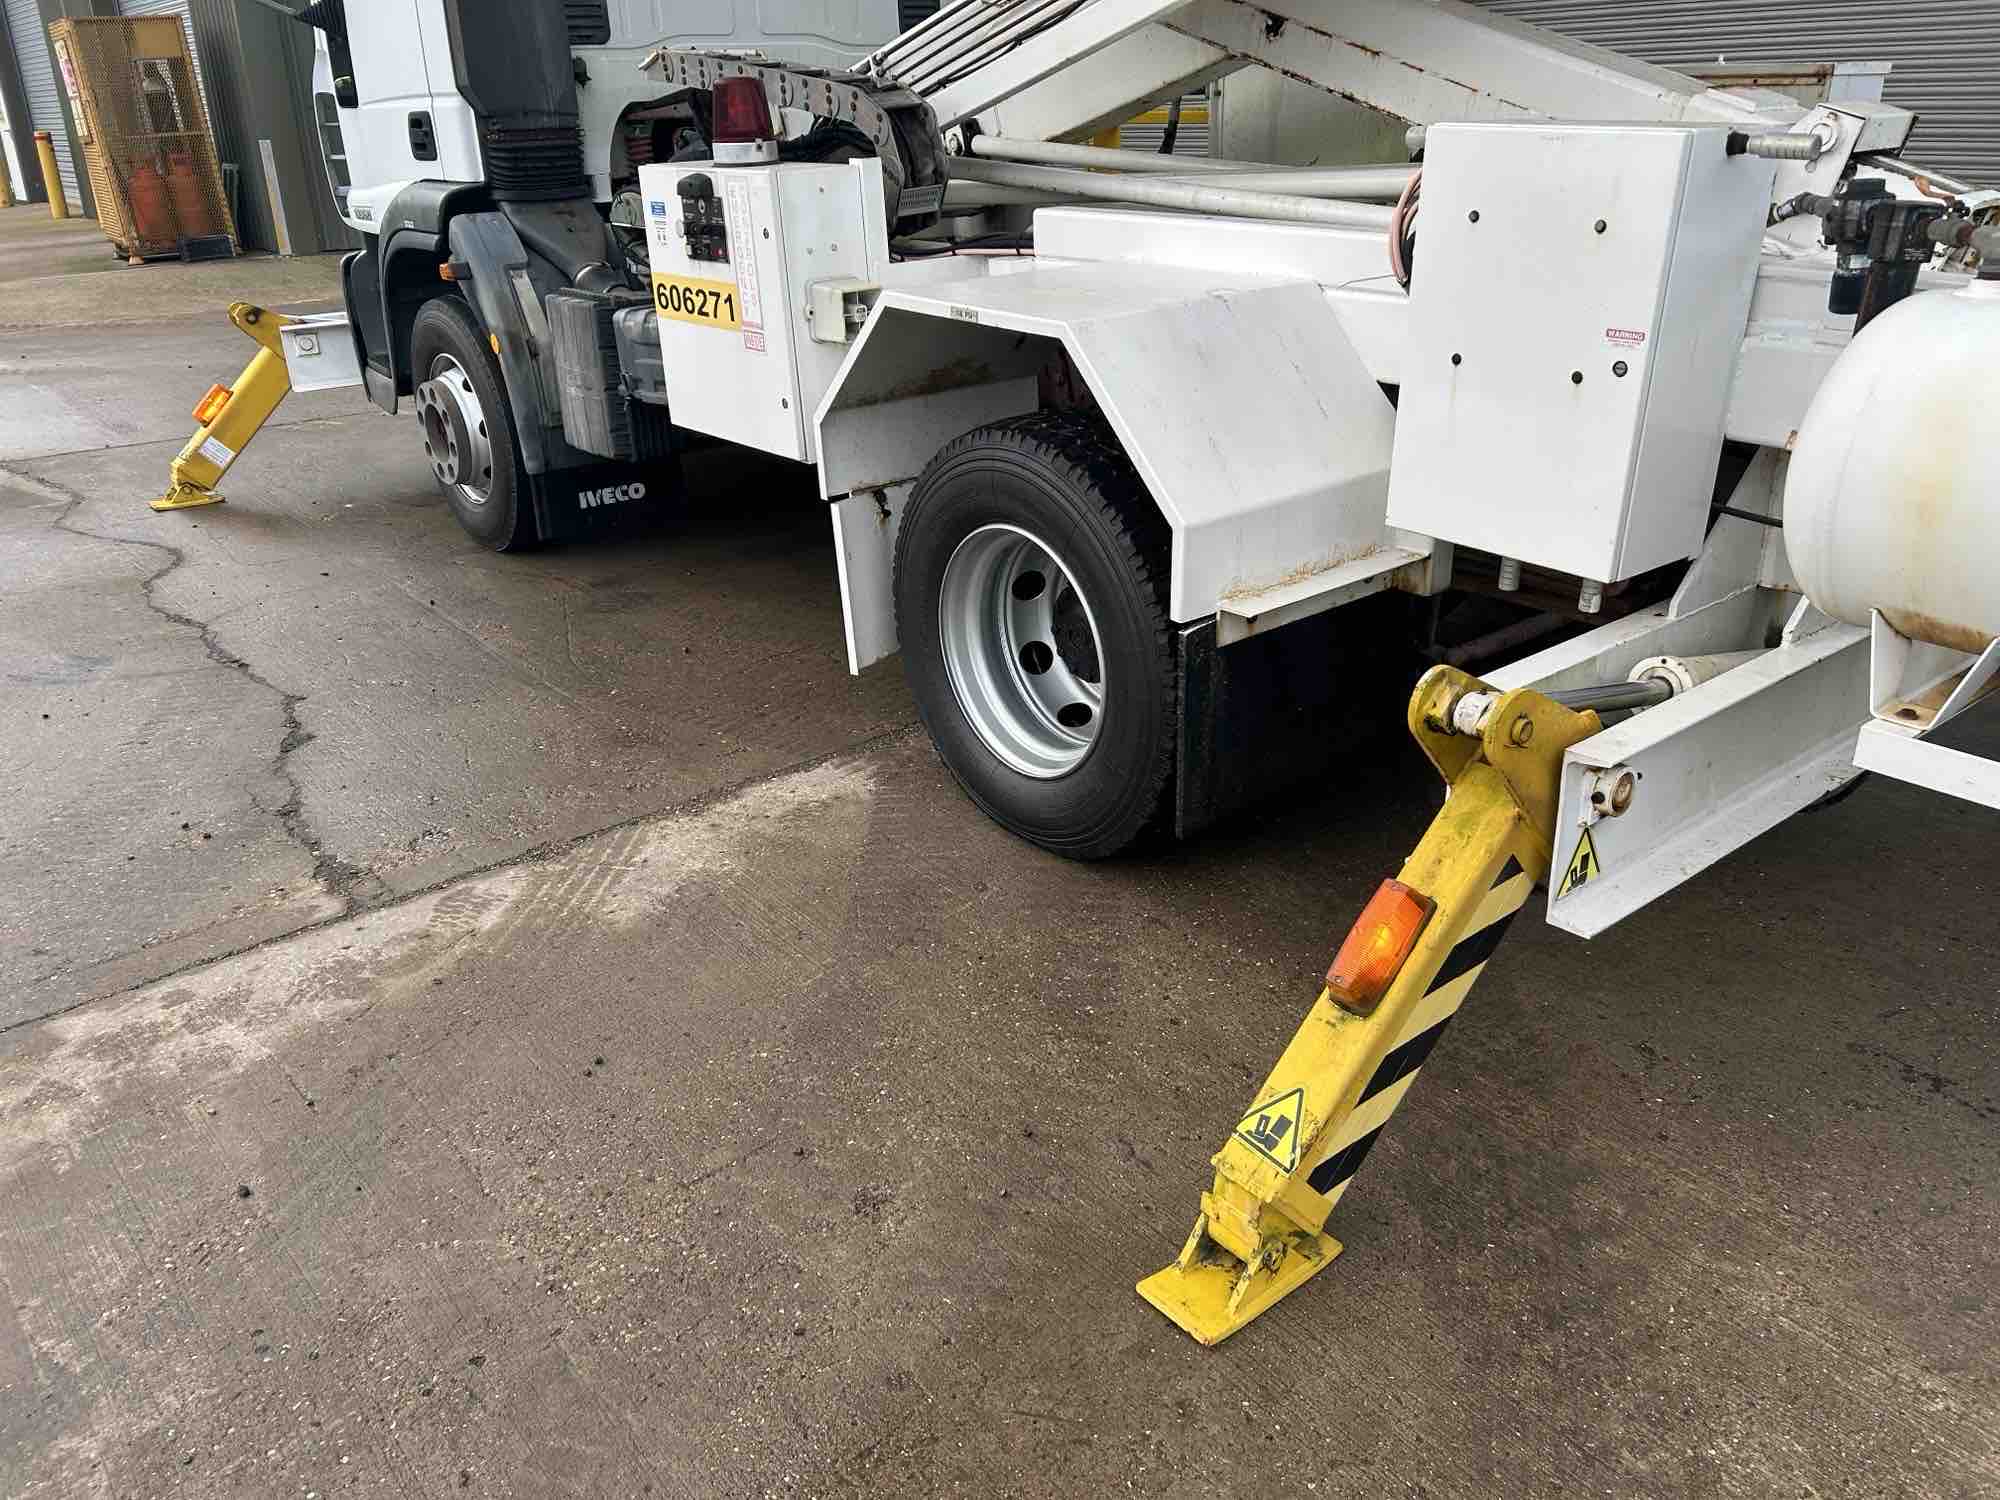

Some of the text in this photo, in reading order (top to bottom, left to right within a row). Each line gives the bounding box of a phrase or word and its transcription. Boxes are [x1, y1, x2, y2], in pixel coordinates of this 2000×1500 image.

[656, 282, 736, 322] 606271
[1607, 330, 1644, 341] WARNING
[578, 482, 646, 509] IVECO
